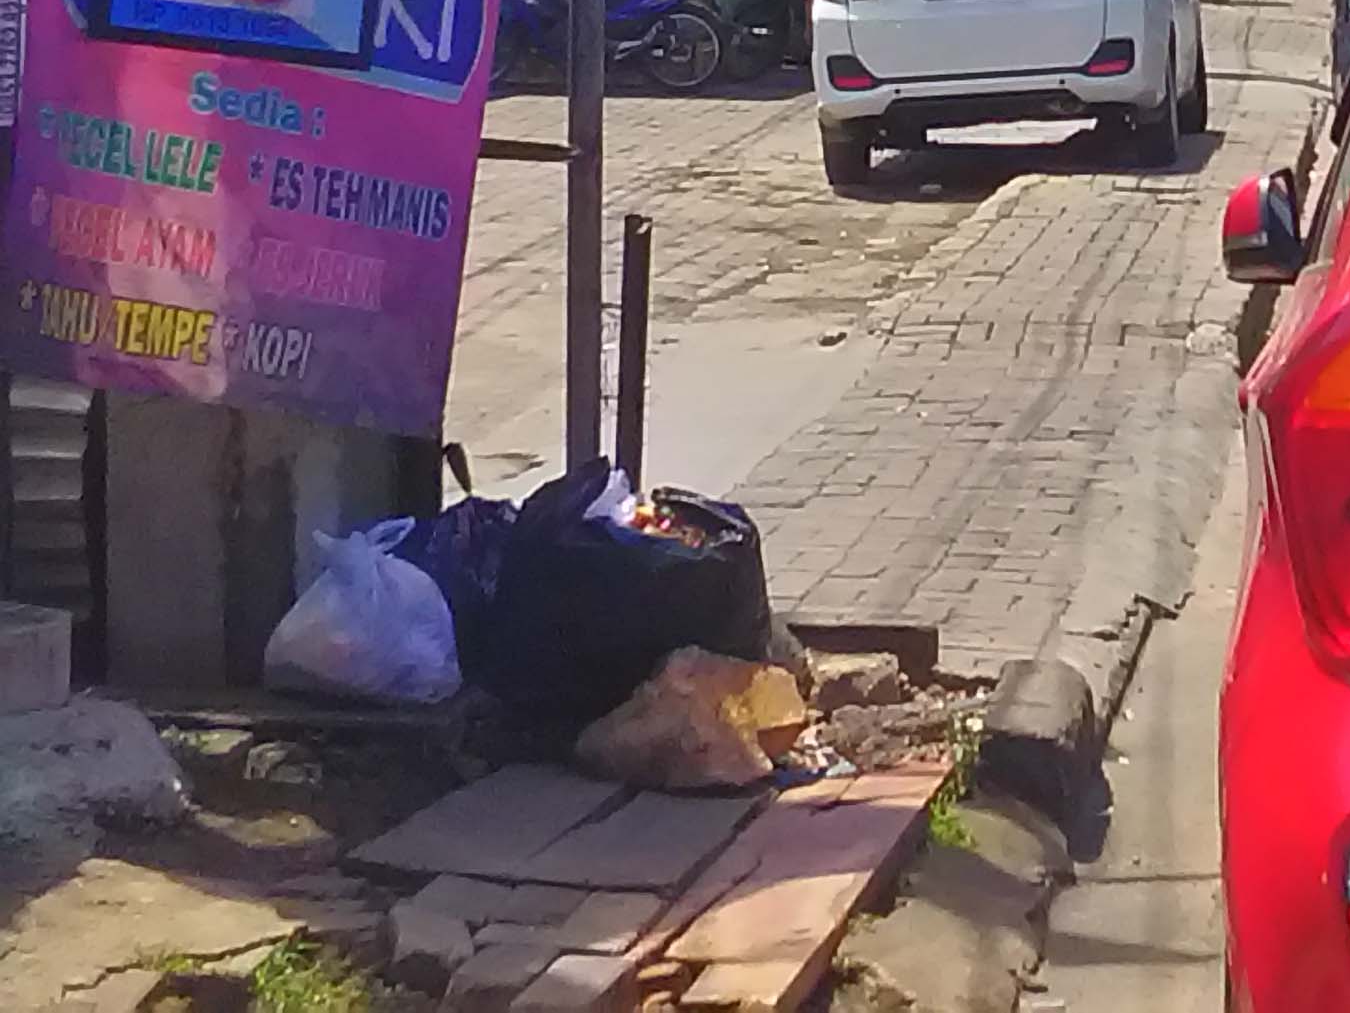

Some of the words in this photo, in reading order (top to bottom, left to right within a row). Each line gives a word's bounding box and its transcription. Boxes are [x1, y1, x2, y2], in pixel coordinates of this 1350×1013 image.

[190, 70, 304, 134] Sedia
[143, 129, 224, 194] LELE
[268, 154, 305, 211] ES
[311, 165, 366, 225] TEH
[366, 178, 451, 240] MANIS
[112, 298, 218, 366] TEMPE
[241, 320, 313, 380] KOPI
